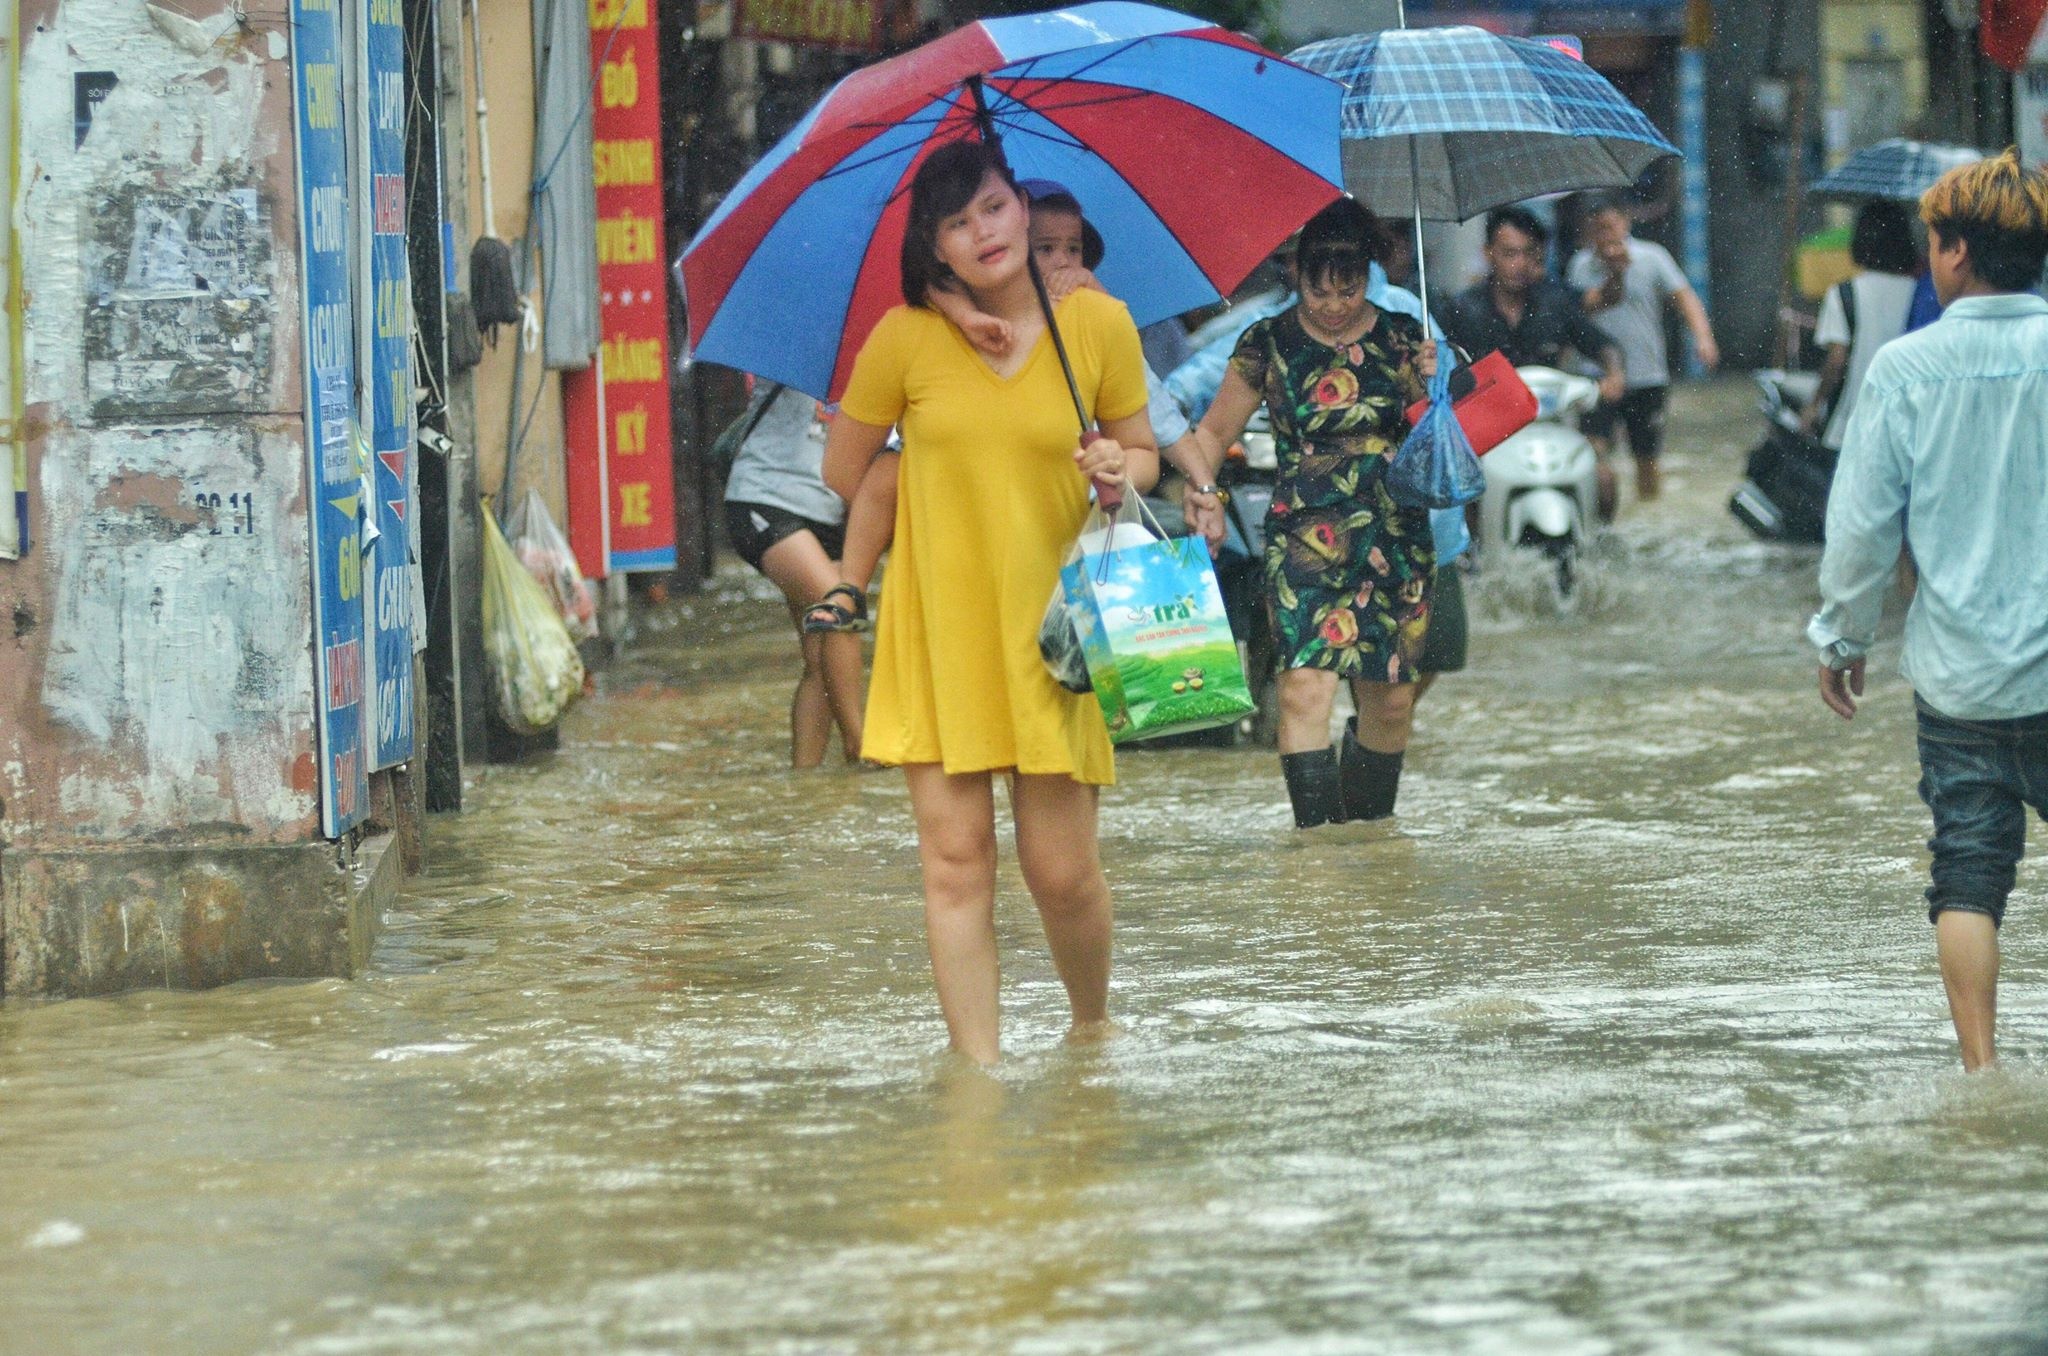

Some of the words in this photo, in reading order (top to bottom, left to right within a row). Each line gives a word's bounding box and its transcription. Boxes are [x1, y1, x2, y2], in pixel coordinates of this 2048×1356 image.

[593, 138, 655, 188] SINH
[596, 207, 656, 265] VIÊN
[615, 402, 648, 456] KÝ
[620, 482, 653, 526] XE
